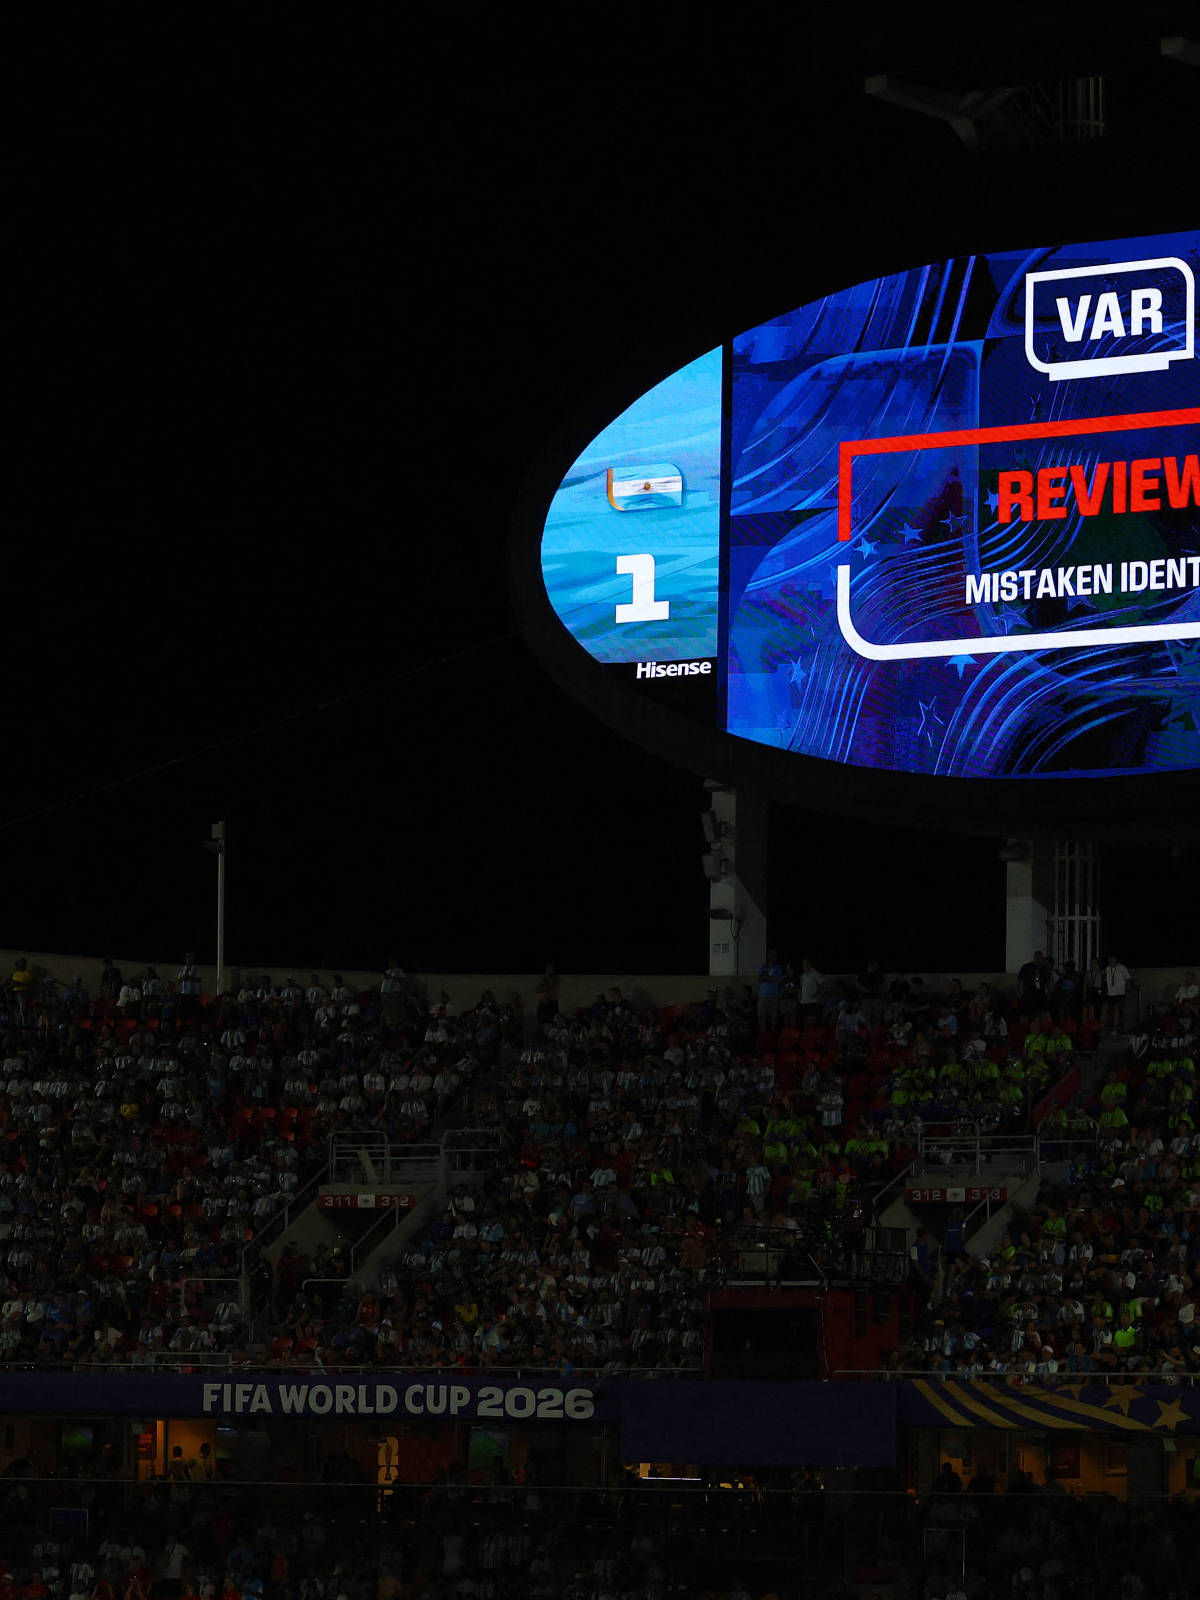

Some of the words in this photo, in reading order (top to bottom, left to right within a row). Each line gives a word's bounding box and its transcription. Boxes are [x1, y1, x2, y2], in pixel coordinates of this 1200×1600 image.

[1055, 287, 1163, 343] VAR
[615, 553, 670, 624] 1
[965, 563, 1113, 605] MISTAKEN
[636, 661, 712, 679] Hisense
[323, 1195, 353, 1208] 311
[911, 1189, 942, 1201] 312
[202, 1383, 273, 1413] FIFA
[278, 1384, 399, 1415] WORLD
[404, 1384, 472, 1416] CUP
[476, 1386, 596, 1420] 2026
